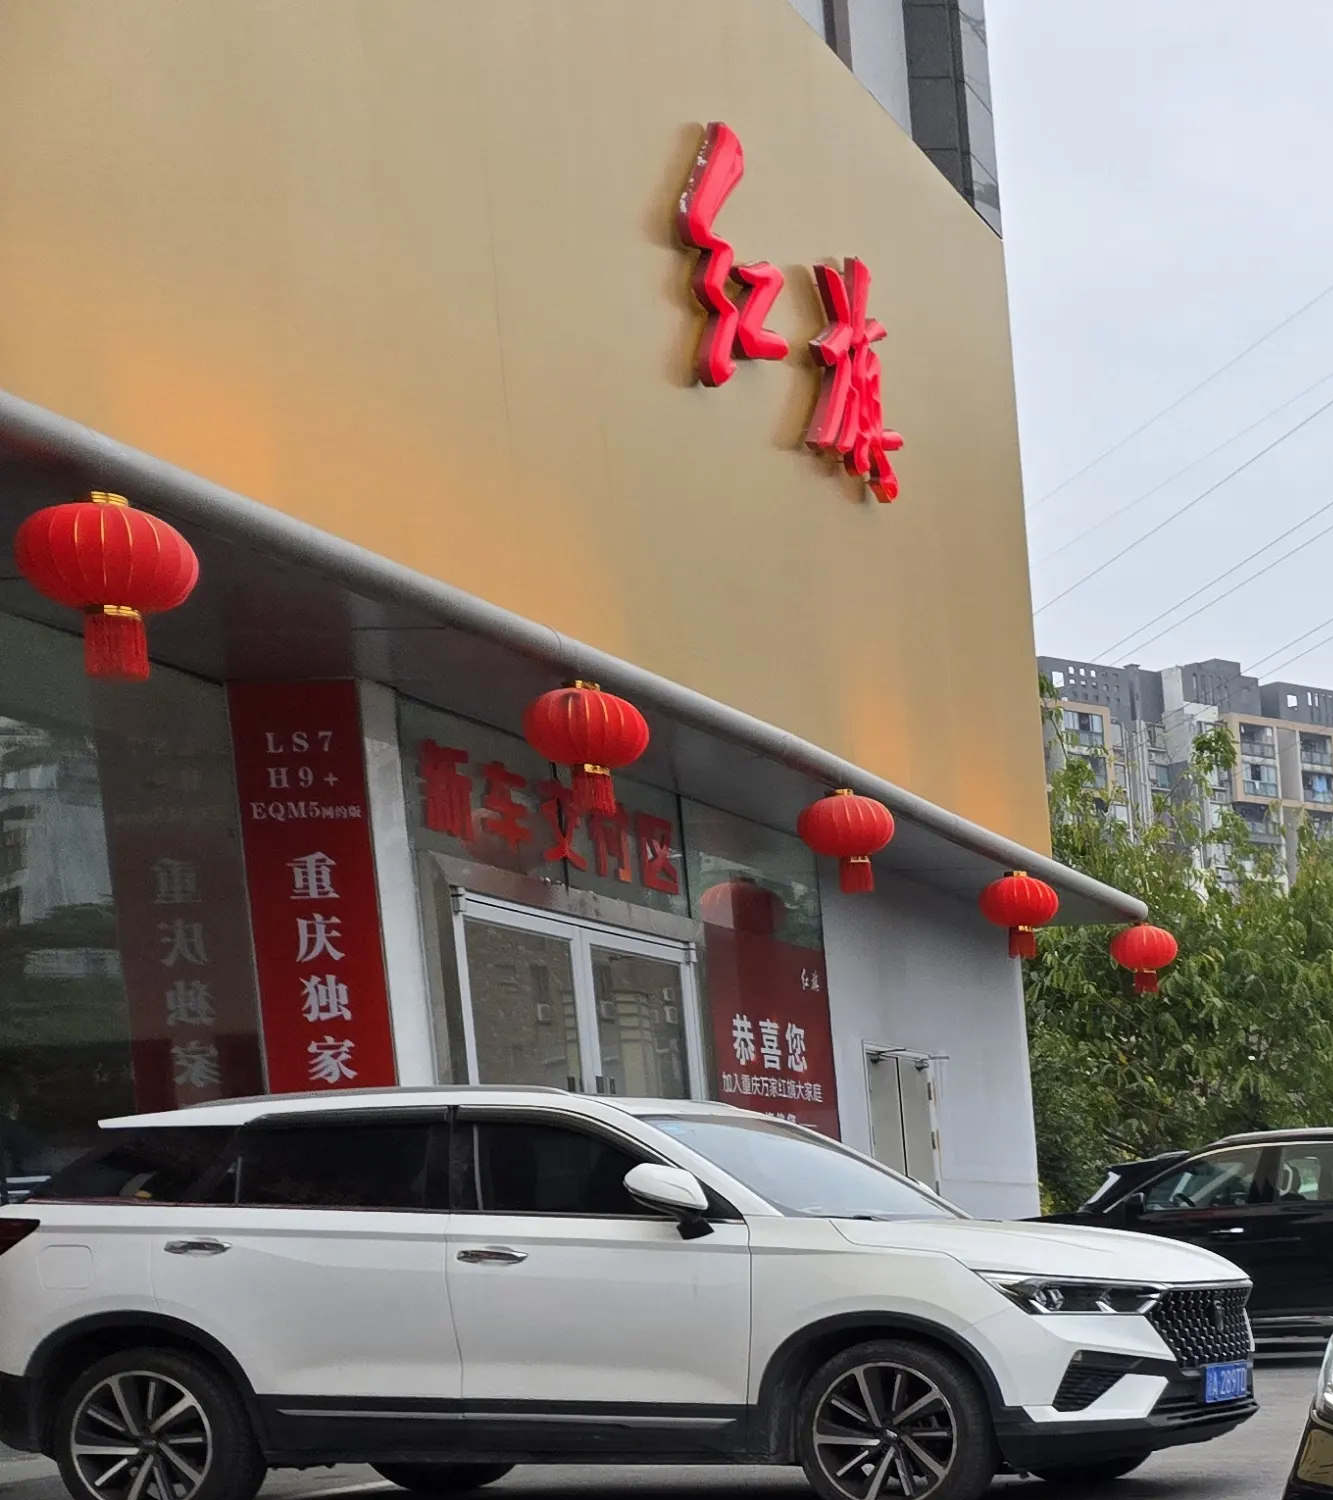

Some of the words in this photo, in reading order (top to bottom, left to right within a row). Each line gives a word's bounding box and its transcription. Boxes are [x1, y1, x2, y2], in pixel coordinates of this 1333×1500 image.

[676, 121, 904, 503] 红旗
[265, 730, 332, 753] LS7
[268, 766, 338, 788] H9+
[419, 739, 679, 895] 新车交付区
[286, 851, 357, 1084] 重庆独家
[732, 1013, 808, 1073] 恭喜您
[722, 1072, 823, 1103] 加入重庆万家红旗大家庭
